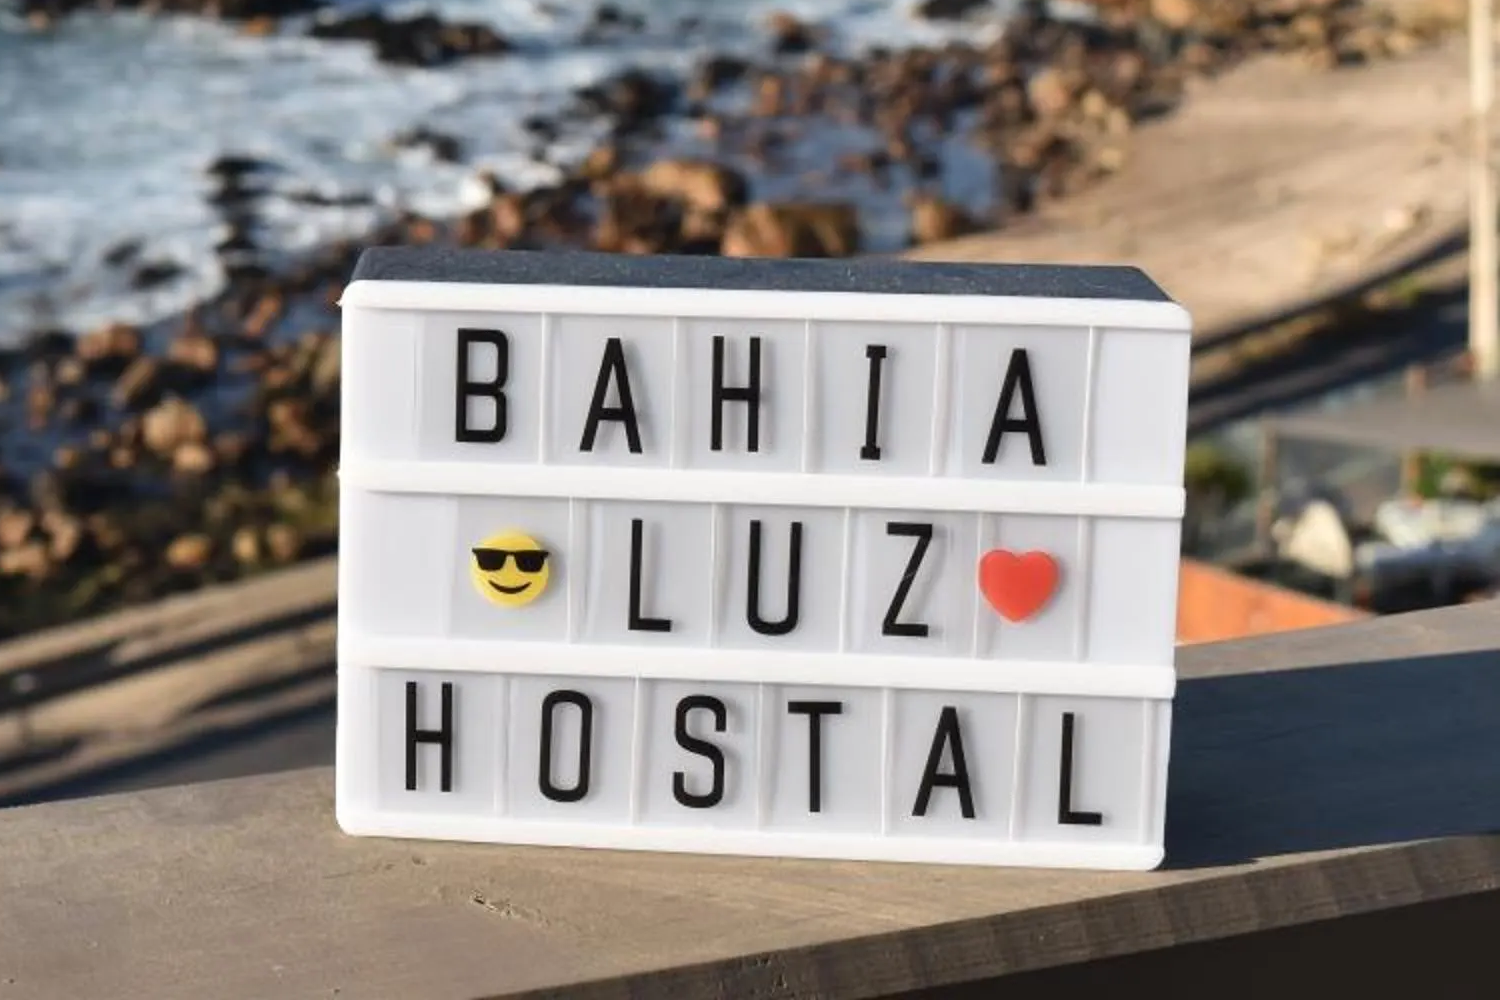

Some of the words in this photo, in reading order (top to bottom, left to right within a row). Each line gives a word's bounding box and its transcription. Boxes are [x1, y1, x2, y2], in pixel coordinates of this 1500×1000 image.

[455, 327, 1047, 467] BAHIA
[627, 518, 934, 638] LUZ
[404, 681, 1103, 826] HOSTAL
